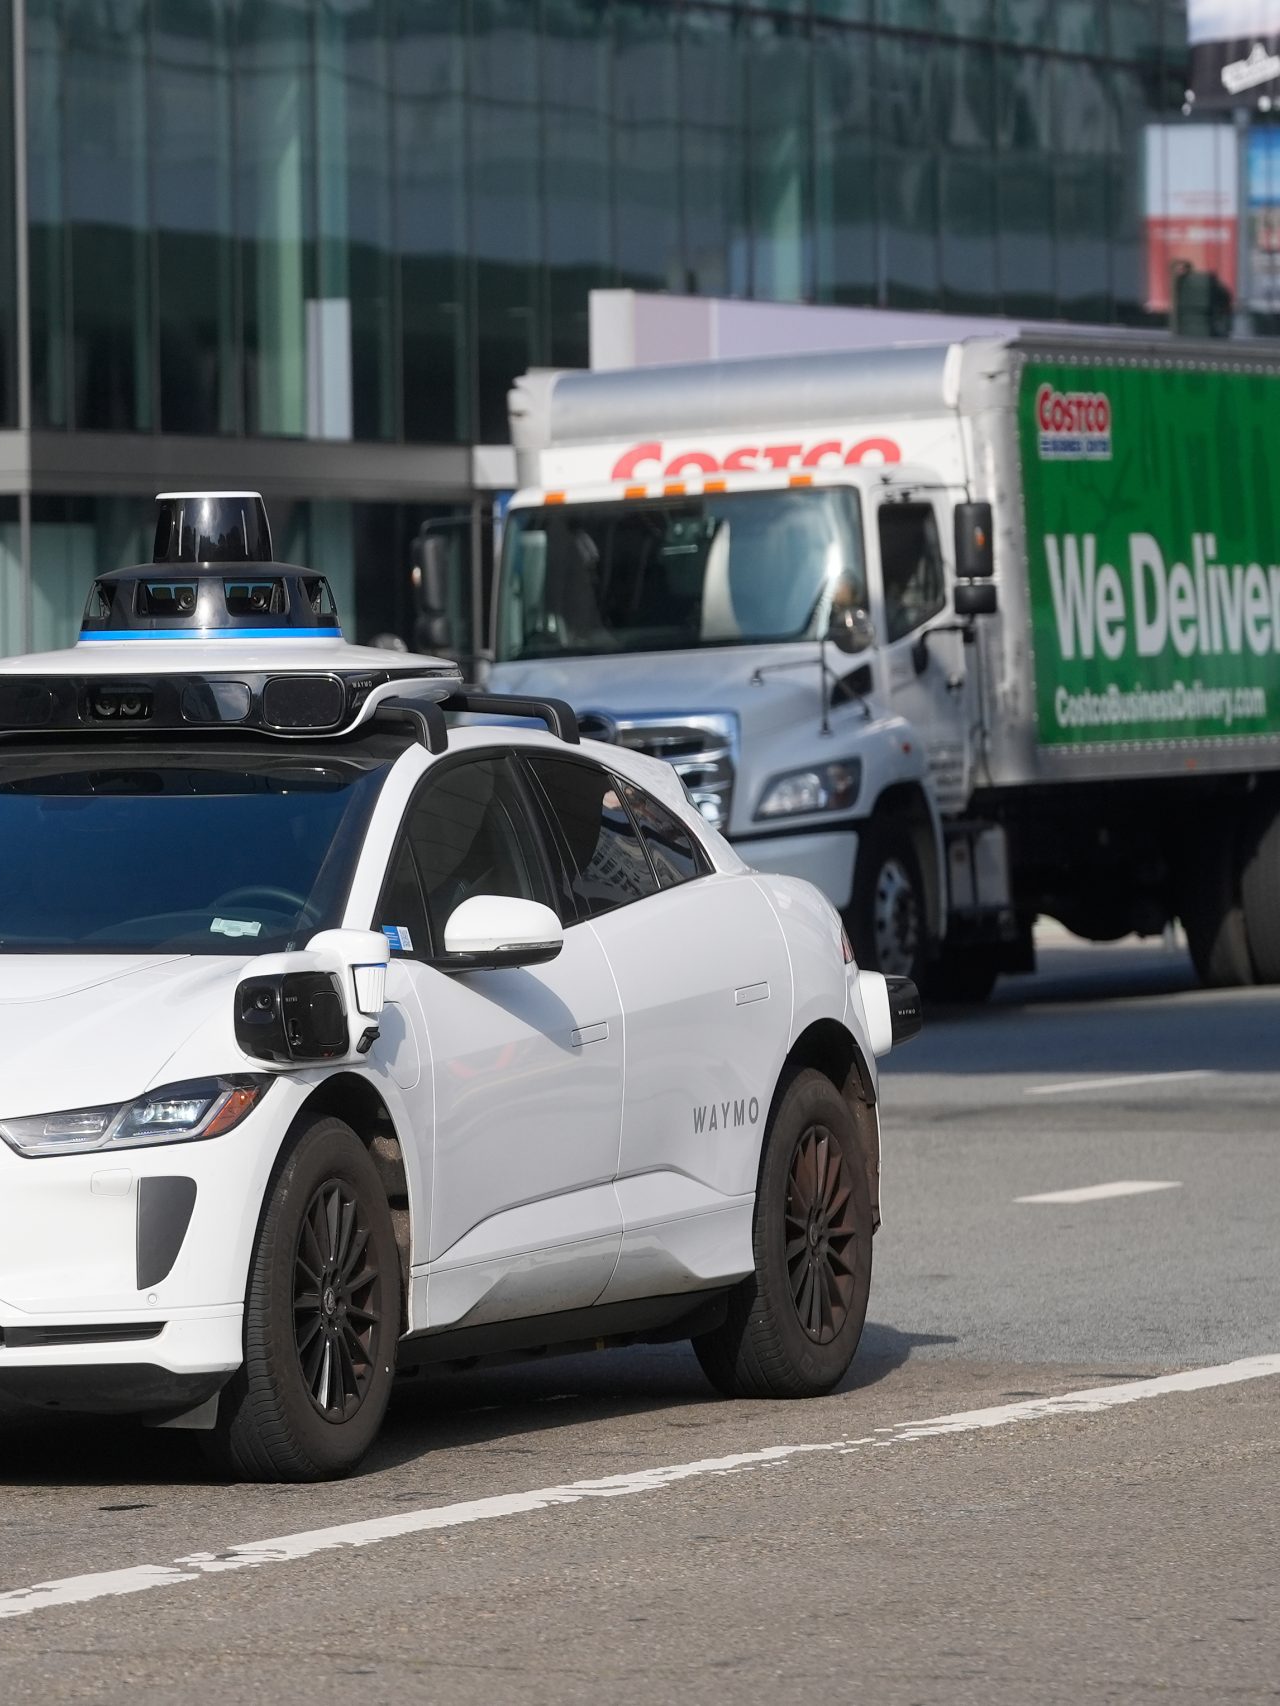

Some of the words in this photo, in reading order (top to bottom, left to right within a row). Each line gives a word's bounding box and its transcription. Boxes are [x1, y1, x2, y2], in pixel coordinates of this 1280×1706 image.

[1039, 389, 1109, 432] COSTCO
[1045, 533, 1126, 660] We
[1055, 681, 1267, 728] CostcoBusinessDelivery.com
[693, 1096, 759, 1134] WAYMO
